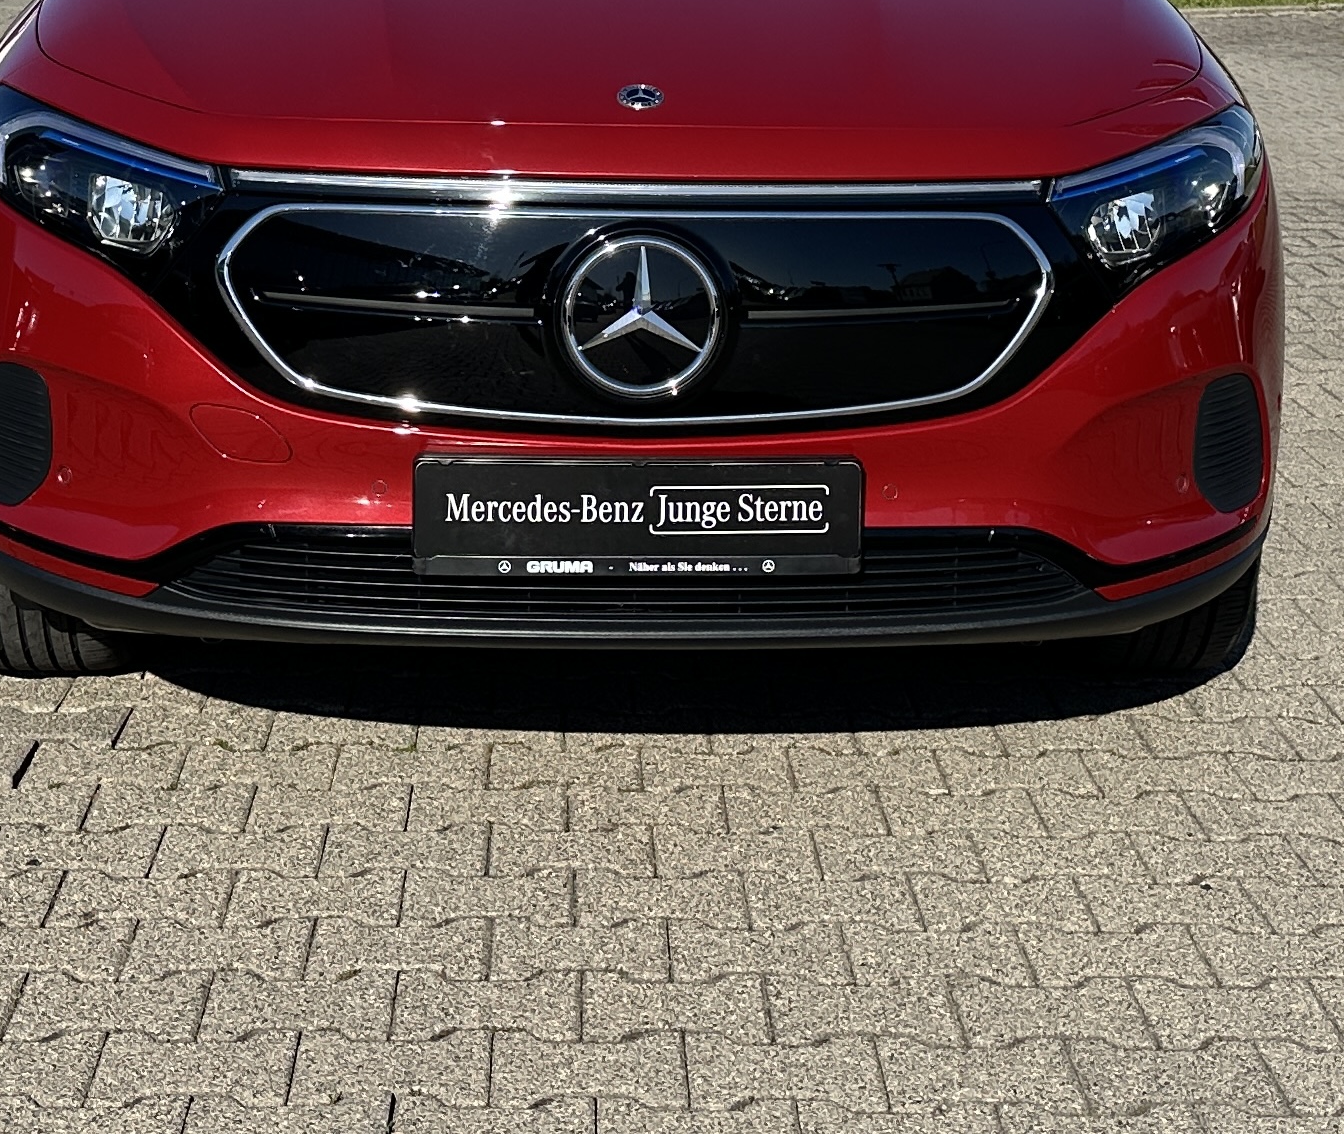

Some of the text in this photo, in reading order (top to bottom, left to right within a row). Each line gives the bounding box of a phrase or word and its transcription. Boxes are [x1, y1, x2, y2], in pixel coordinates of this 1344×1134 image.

[445, 493, 823, 529] Mercedes-Benz Junge Sterne
[527, 561, 594, 573] GRUMA
[661, 562, 675, 572] als
[677, 562, 693, 572] Sie
[695, 562, 731, 572] denken
